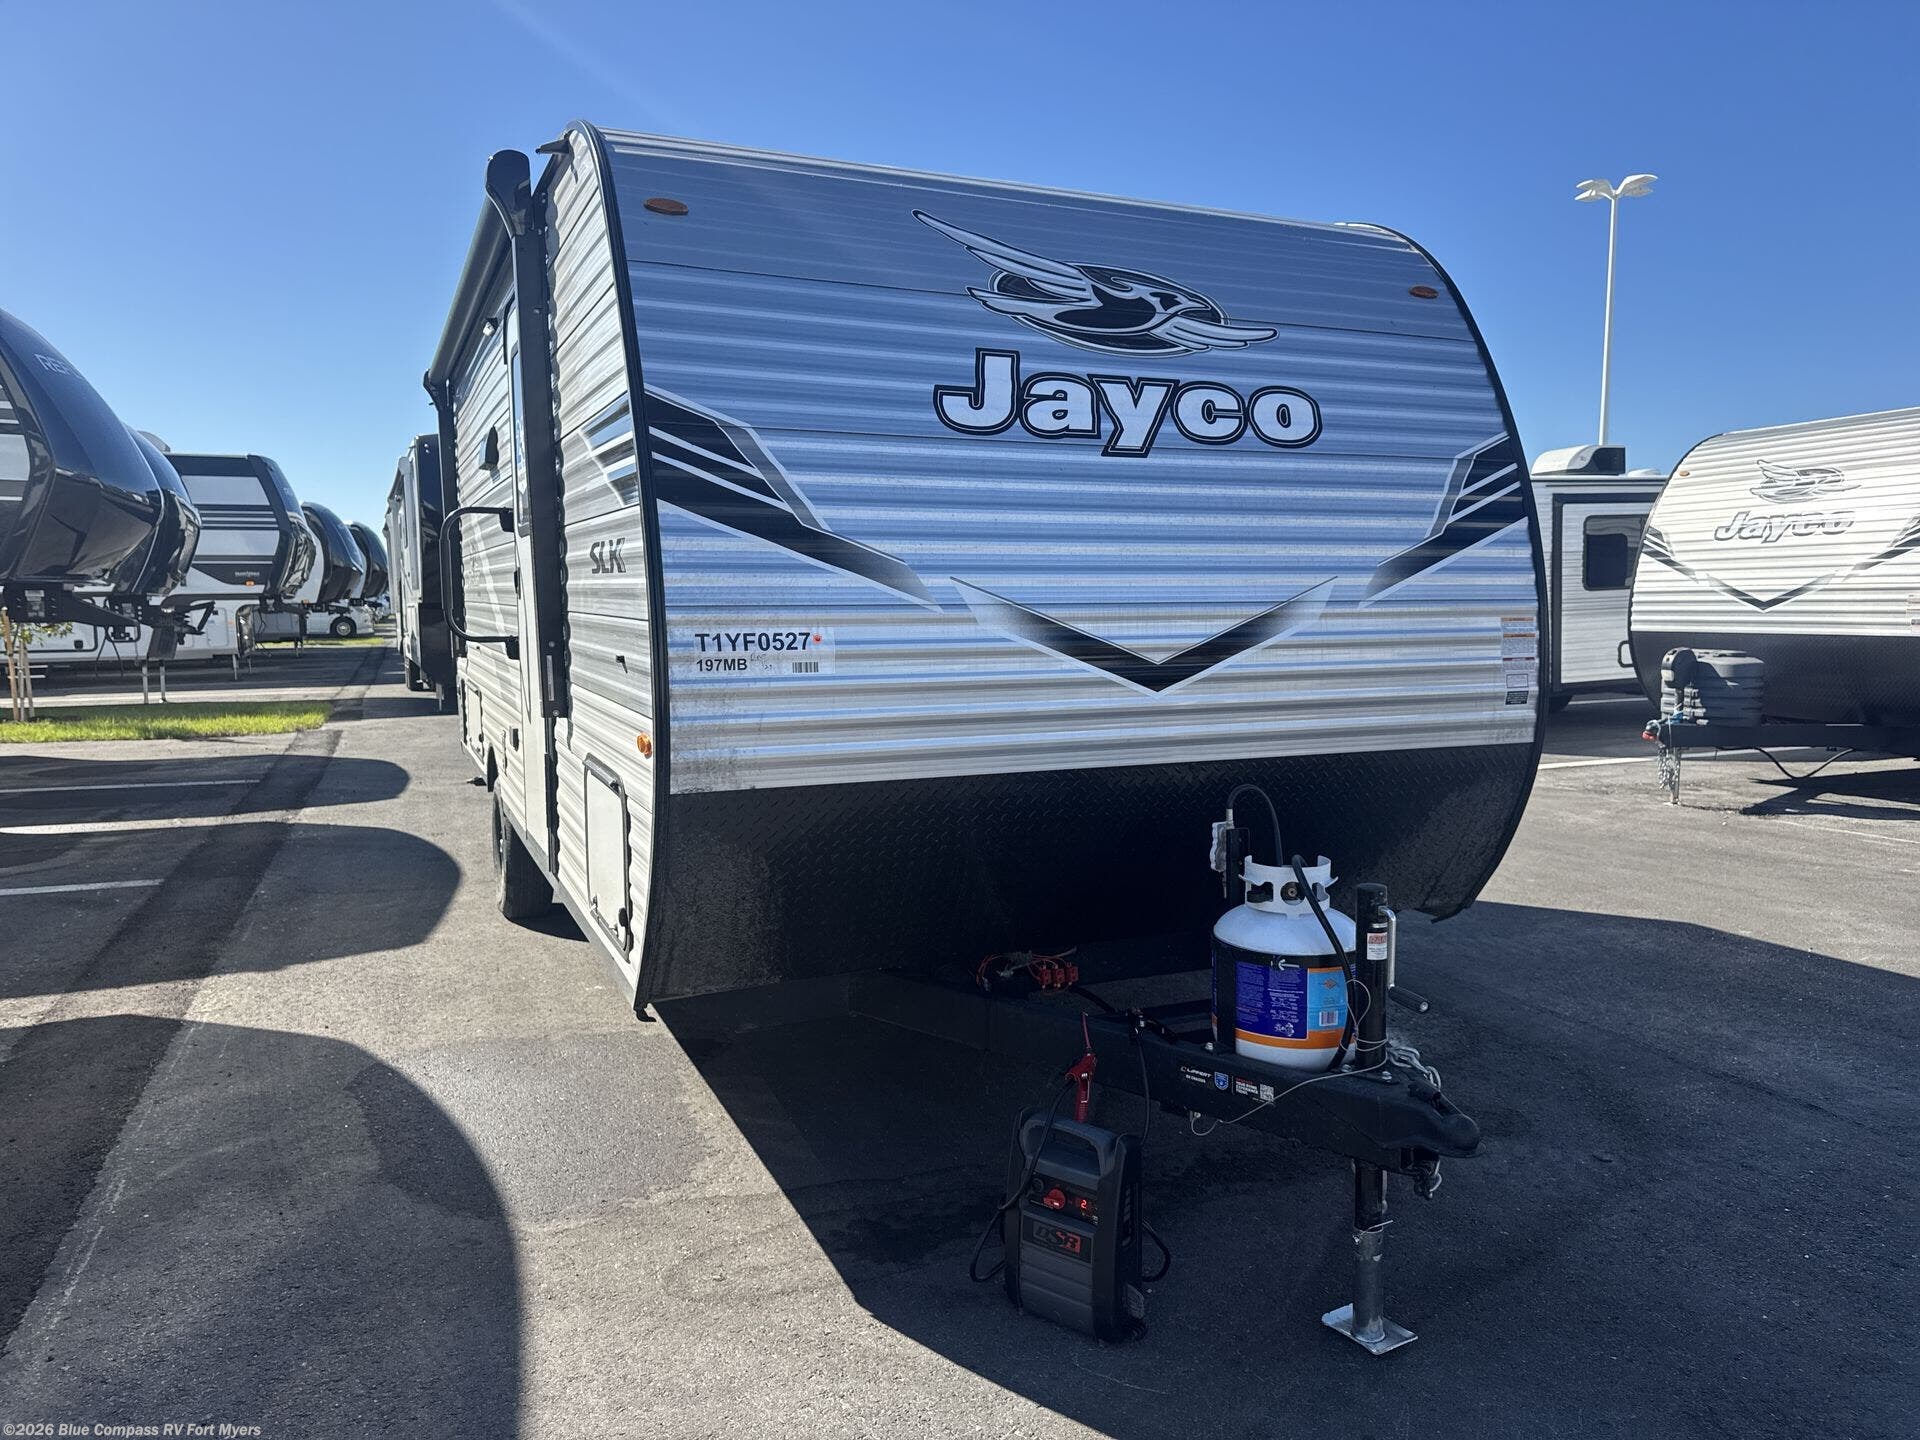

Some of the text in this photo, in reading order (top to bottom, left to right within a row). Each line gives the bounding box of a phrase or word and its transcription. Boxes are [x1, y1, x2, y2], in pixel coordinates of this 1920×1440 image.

[933, 347, 1323, 458] Jayco
[1713, 510, 1856, 544] Jayco
[589, 537, 627, 574] SLK
[694, 632, 811, 652] T1YF0527
[696, 658, 748, 672] 197MB
